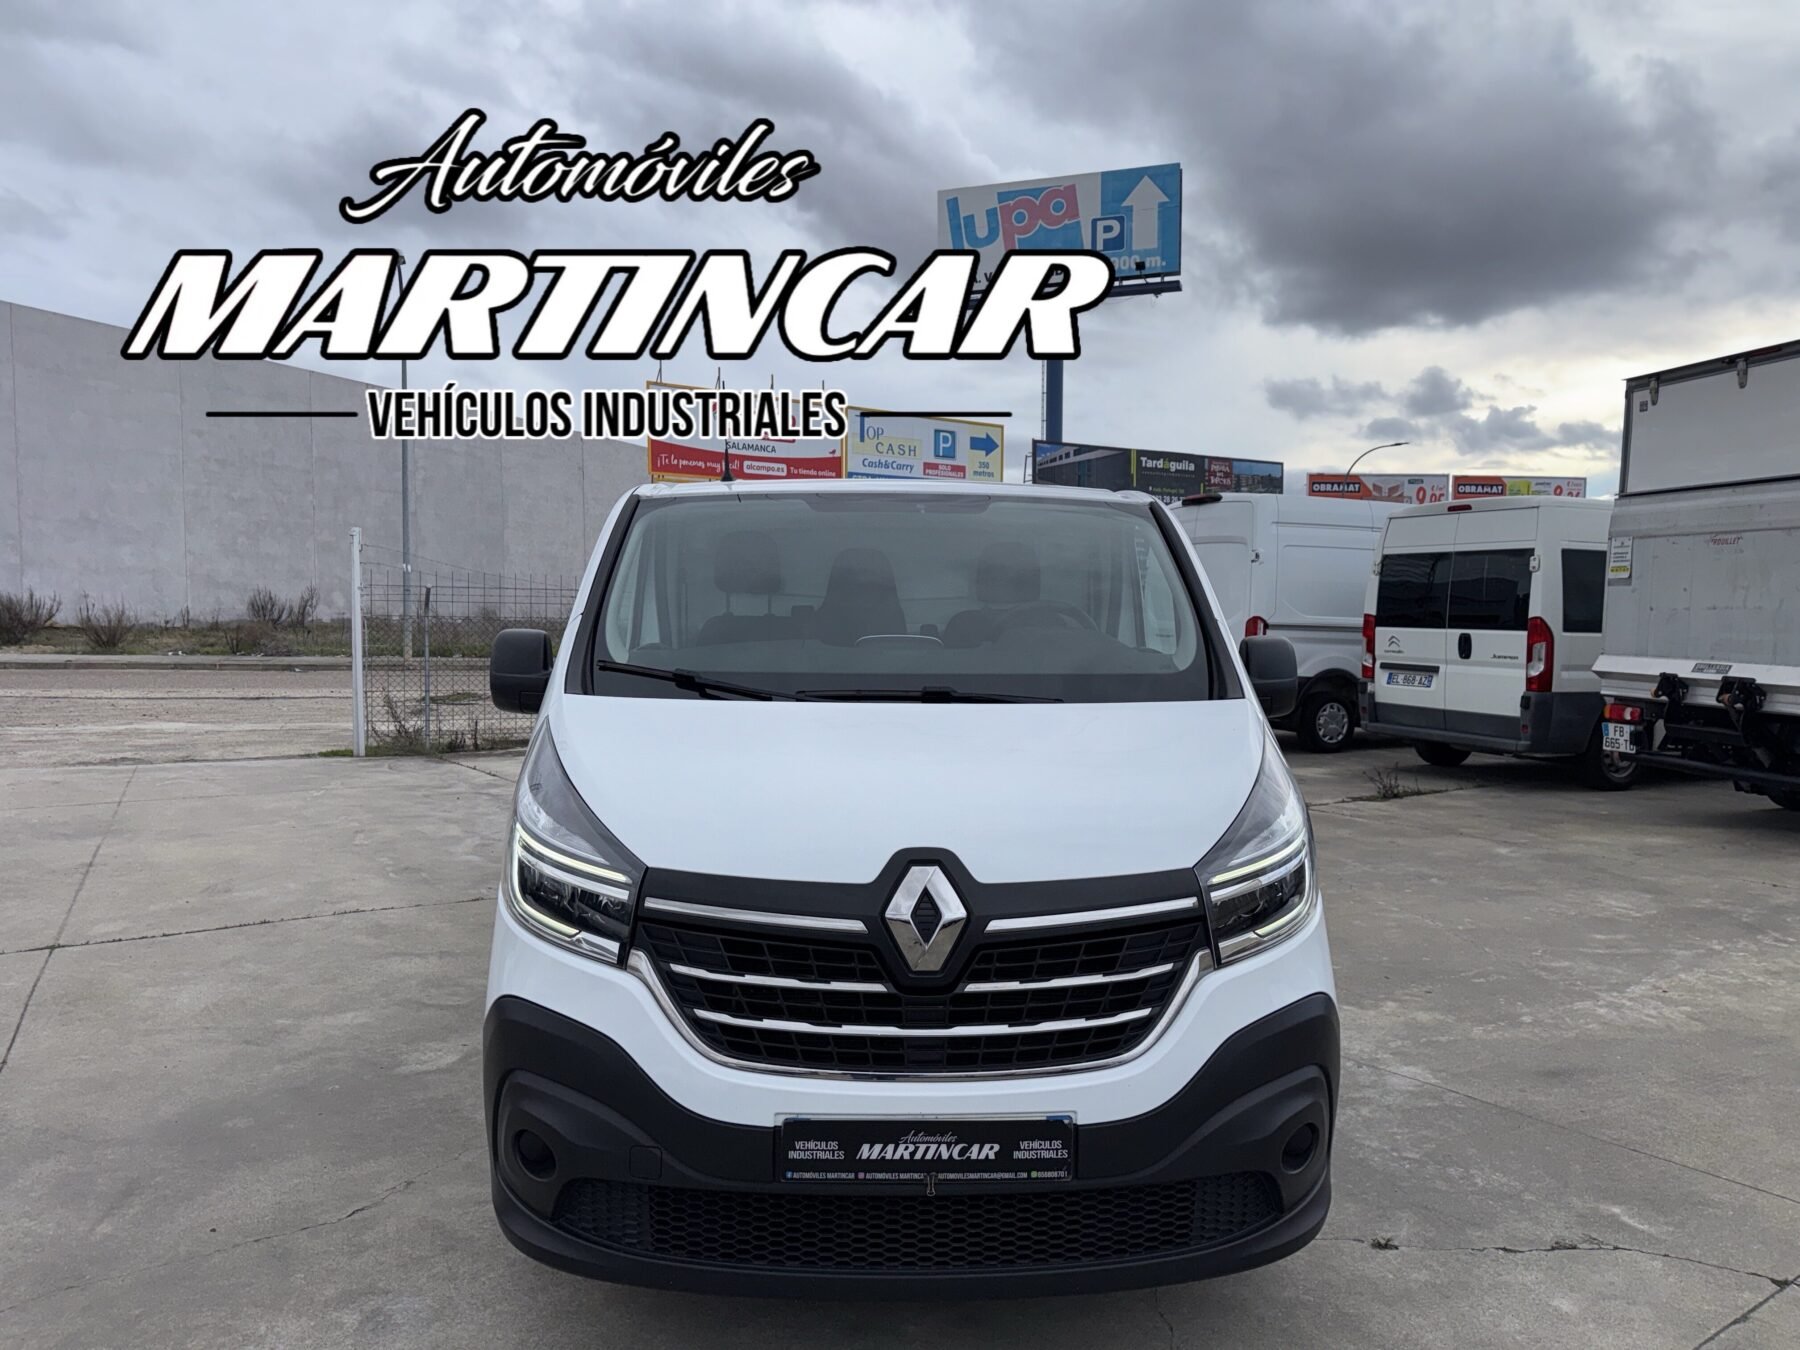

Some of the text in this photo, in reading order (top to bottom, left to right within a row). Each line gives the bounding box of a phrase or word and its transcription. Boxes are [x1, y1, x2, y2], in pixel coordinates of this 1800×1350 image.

[946, 183, 1081, 249] lupa
[1097, 218, 1121, 249] P
[726, 441, 777, 454] SALAMANCA
[875, 442, 917, 457] CASH
[939, 432, 952, 456] P
[679, 459, 705, 469] ponemos
[706, 461, 721, 473] muy
[722, 458, 740, 471] fcil!
[745, 463, 786, 474] alcampo.es
[862, 457, 915, 474] Cash&Carry
[978, 461, 990, 470] 350
[1140, 456, 1195, 472] Tardáguila
[790, 466, 837, 478] Tu tienda online
[972, 469, 995, 479] metros
[1312, 483, 1360, 492] OBRAMAT
[1458, 485, 1503, 494] OBRAMAT
[899, 1129, 958, 1144] Automóviles
[794, 1139, 839, 1150] VEHÍCULOS
[1019, 1139, 1063, 1150] VEHÍCULOS
[788, 1150, 845, 1160] INDUSTRIALES
[856, 1143, 1000, 1160] MARTINCAR
[1013, 1149, 1069, 1160] INDUSTRIALES
[827, 1171, 856, 1179] MARTINCAR
[900, 1172, 926, 1180] MARTINCA
